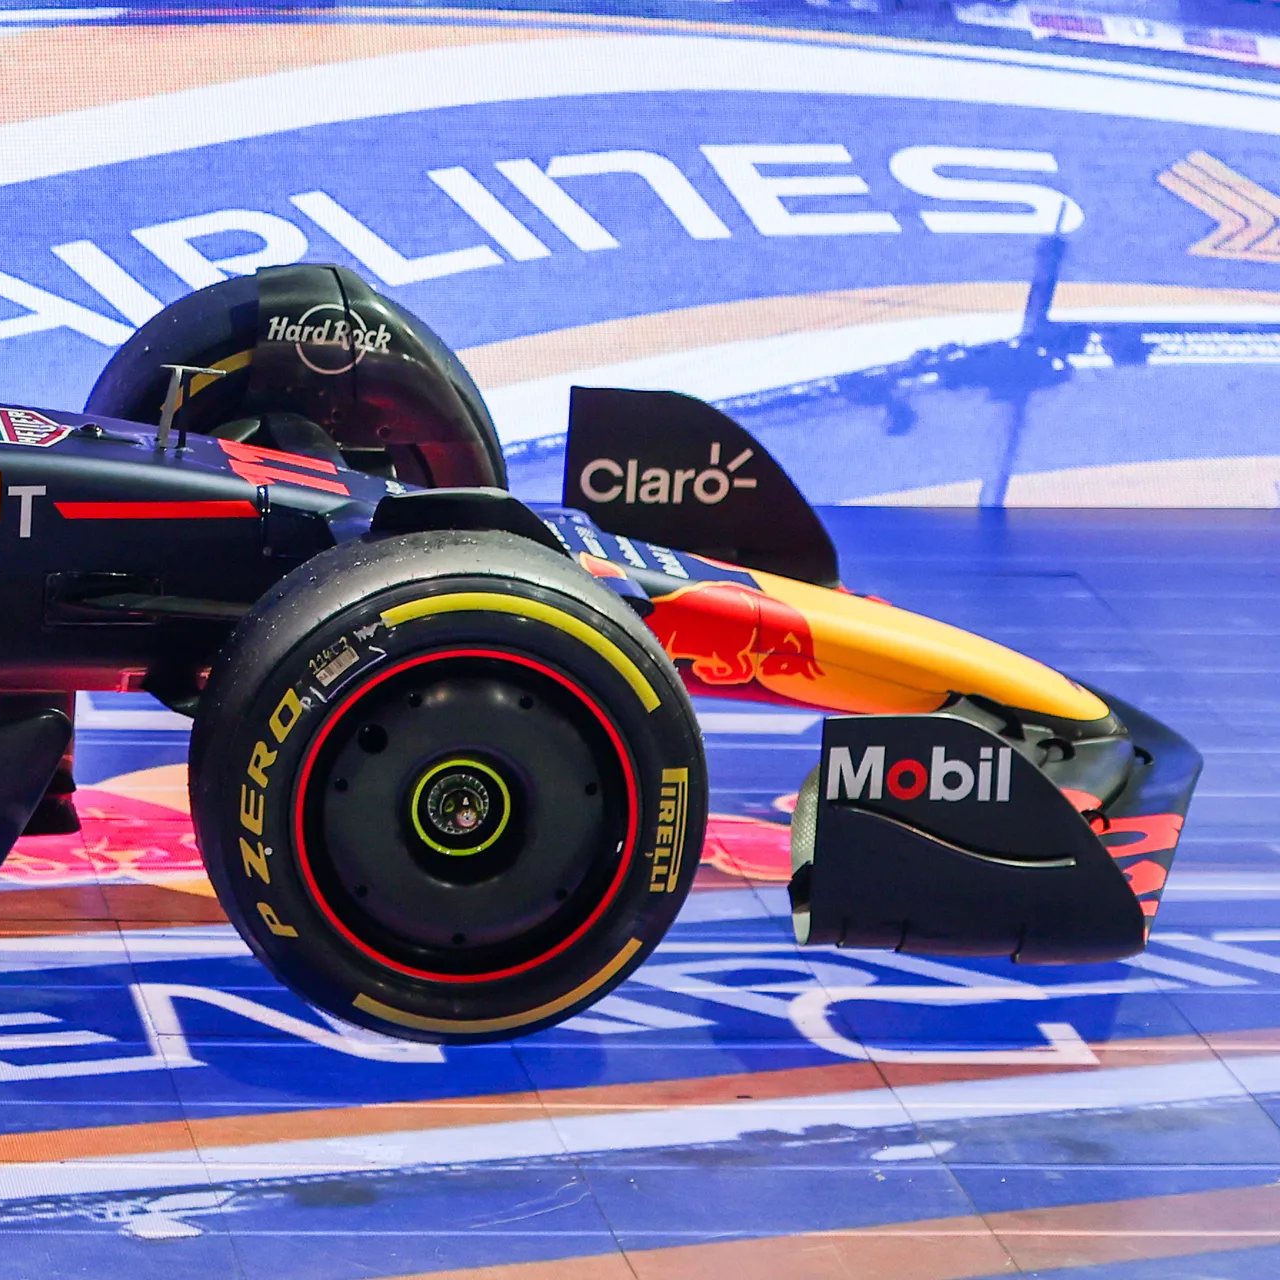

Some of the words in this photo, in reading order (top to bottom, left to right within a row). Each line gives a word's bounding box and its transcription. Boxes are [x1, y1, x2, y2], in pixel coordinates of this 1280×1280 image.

[268, 318, 330, 348] Hard
[324, 322, 392, 356] Rock
[9, 409, 56, 445] HEUER
[579, 457, 730, 506] Claro
[240, 687, 305, 885] ZERO
[825, 745, 1013, 804] Mobil
[647, 766, 690, 894] PIRELLI
[257, 904, 299, 940] P
